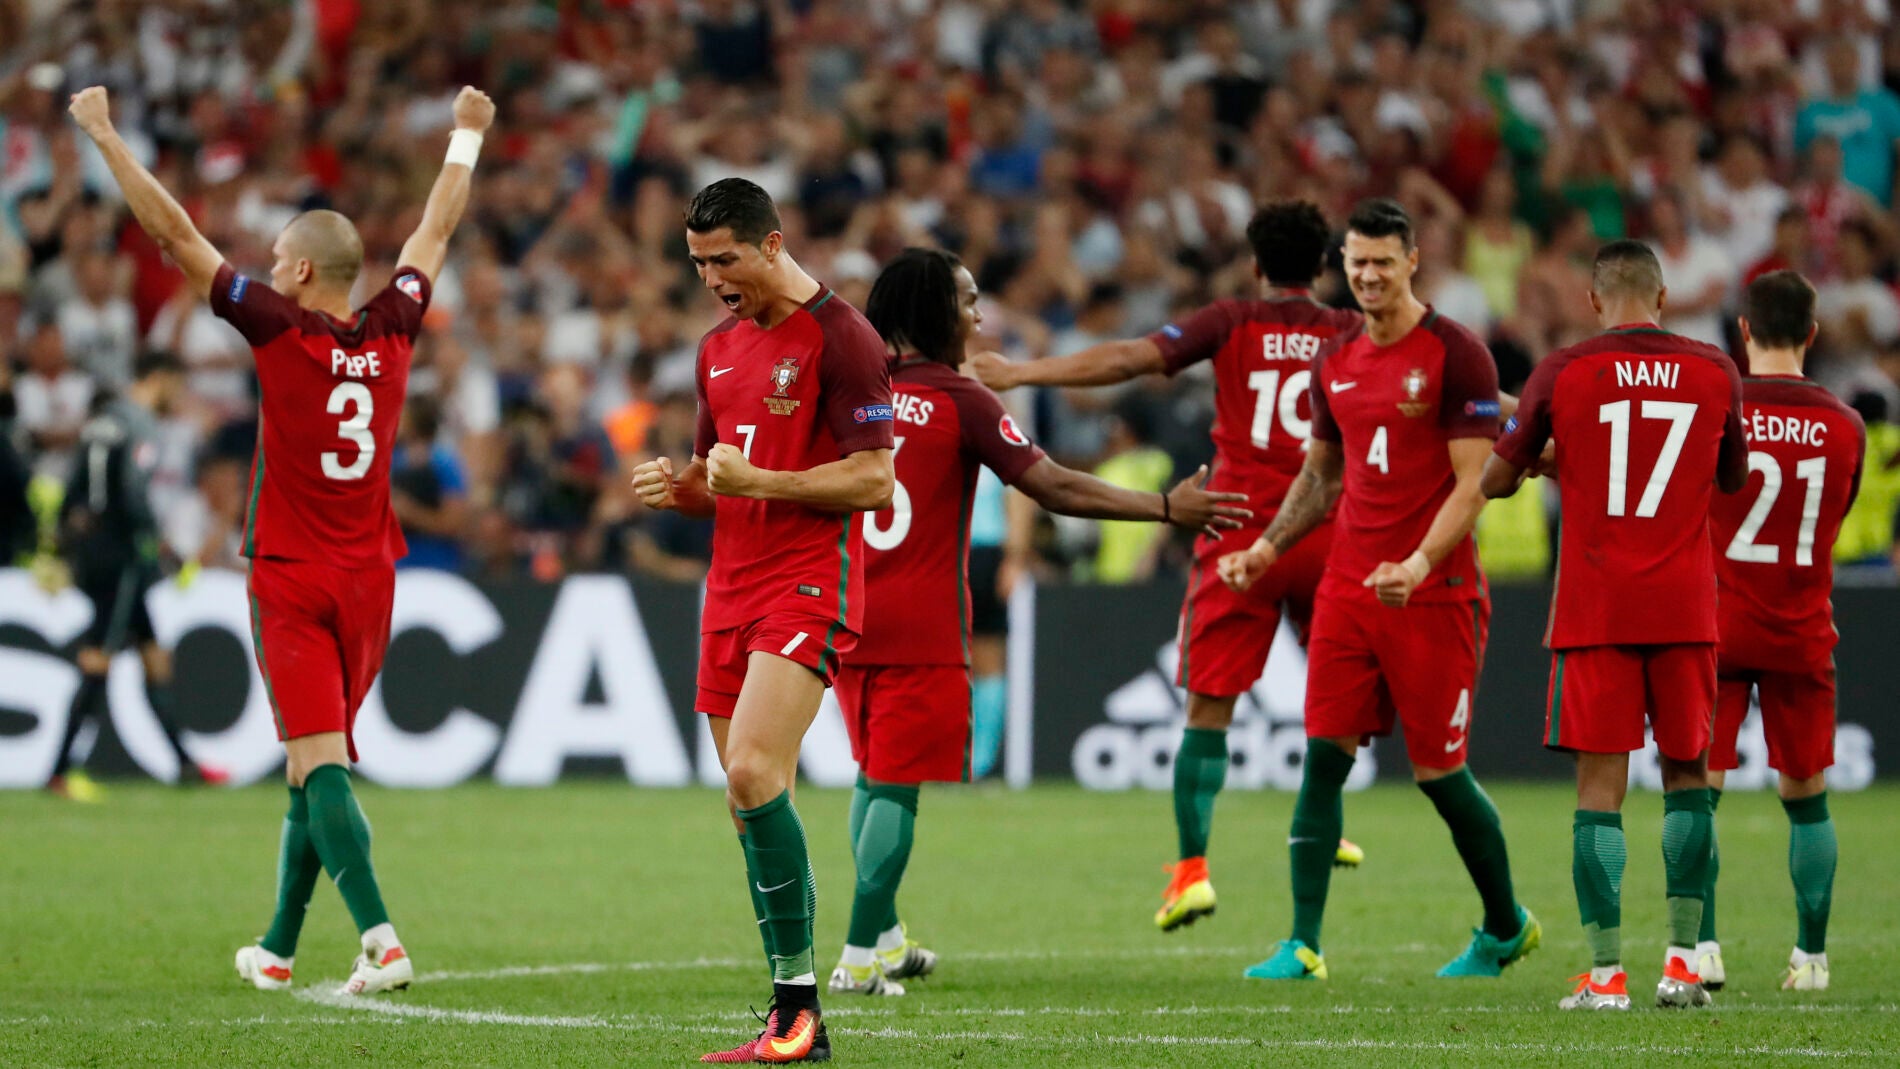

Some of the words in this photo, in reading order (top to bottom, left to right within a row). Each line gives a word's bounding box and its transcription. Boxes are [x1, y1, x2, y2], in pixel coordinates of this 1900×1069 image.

[331, 348, 381, 378] PEPE
[1615, 360, 1680, 390] NANI
[320, 381, 375, 481] 3
[867, 408, 893, 418] RESPEC
[735, 424, 757, 462] 7
[1366, 425, 1390, 475] 4
[1599, 399, 1699, 518] 17
[1725, 451, 1827, 567] 21
[0, 568, 870, 787] SOCA
[1449, 688, 1469, 734] 4
